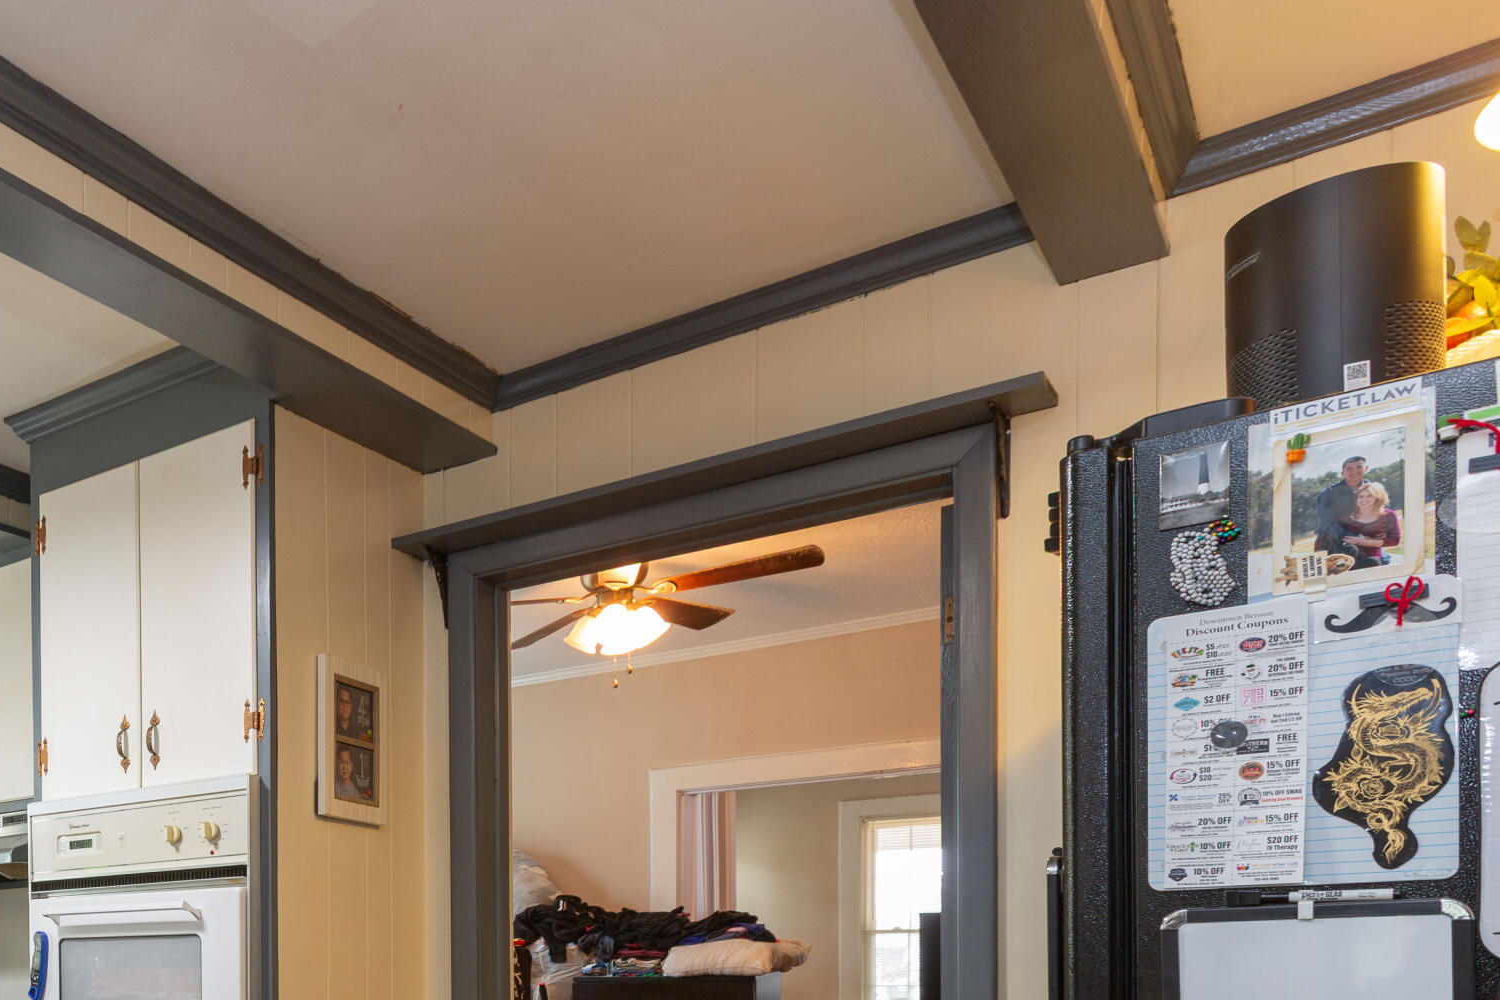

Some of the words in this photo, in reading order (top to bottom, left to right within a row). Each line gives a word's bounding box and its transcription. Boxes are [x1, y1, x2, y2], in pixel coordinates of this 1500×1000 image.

[1274, 383, 1417, 425] iTICKET.LAW
[1244, 611, 1274, 620] Benson
[1186, 623, 1234, 637] Discount
[1237, 617, 1289, 629] Coupons
[1268, 634, 1287, 643] 20%
[1288, 631, 1305, 640] OFF
[1206, 643, 1215, 651] $5
[1268, 664, 1287, 673] 20%
[1288, 661, 1305, 671] OFF
[1205, 668, 1226, 677] FREE
[1269, 688, 1287, 698] 15%
[1288, 686, 1305, 696] OFF
[1204, 695, 1214, 704] $2
[1216, 694, 1231, 703] OFF
[1200, 719, 1217, 728] 10%
[1277, 733, 1298, 741] FREE
[1266, 760, 1284, 769] 15%
[1285, 759, 1301, 768] OFF
[1200, 766, 1211, 774] $10
[1198, 818, 1216, 826] 20%
[1217, 816, 1232, 825] OFF
[1265, 814, 1282, 822] 15%
[1283, 813, 1299, 821] OFF
[1283, 835, 1299, 844] OFF
[1217, 841, 1232, 850] OFF
[1274, 844, 1298, 852] Therapy
[1210, 867, 1225, 875] OFF
